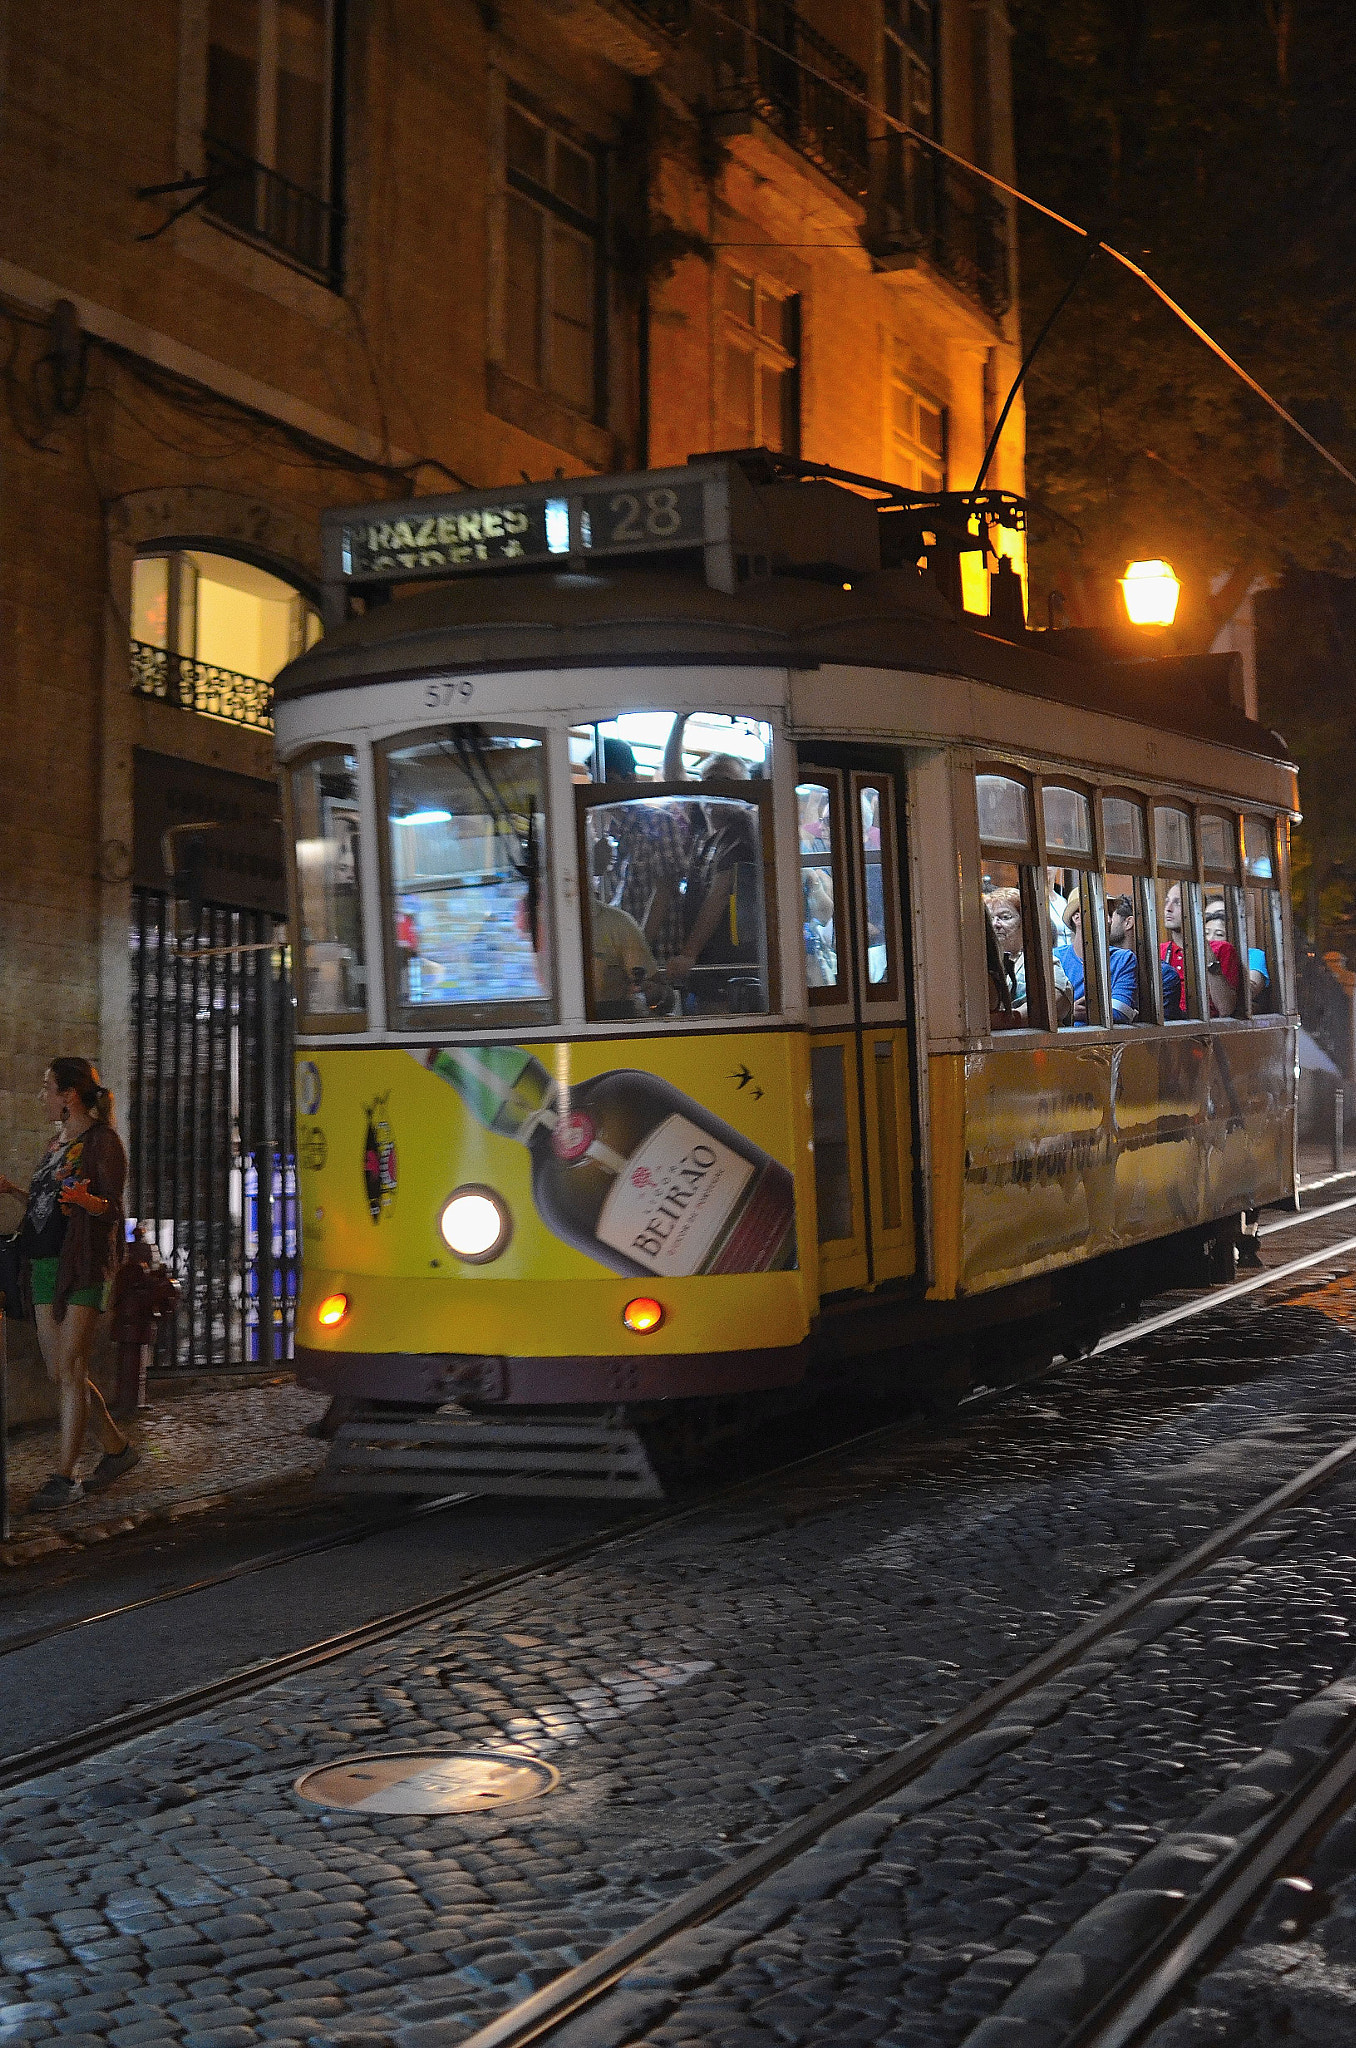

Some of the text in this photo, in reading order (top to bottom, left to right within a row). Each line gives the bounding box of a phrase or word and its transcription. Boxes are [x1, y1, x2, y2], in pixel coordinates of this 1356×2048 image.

[610, 488, 682, 540] 28
[424, 681, 474, 708] 579
[632, 1145, 717, 1257] BEIRÃO
